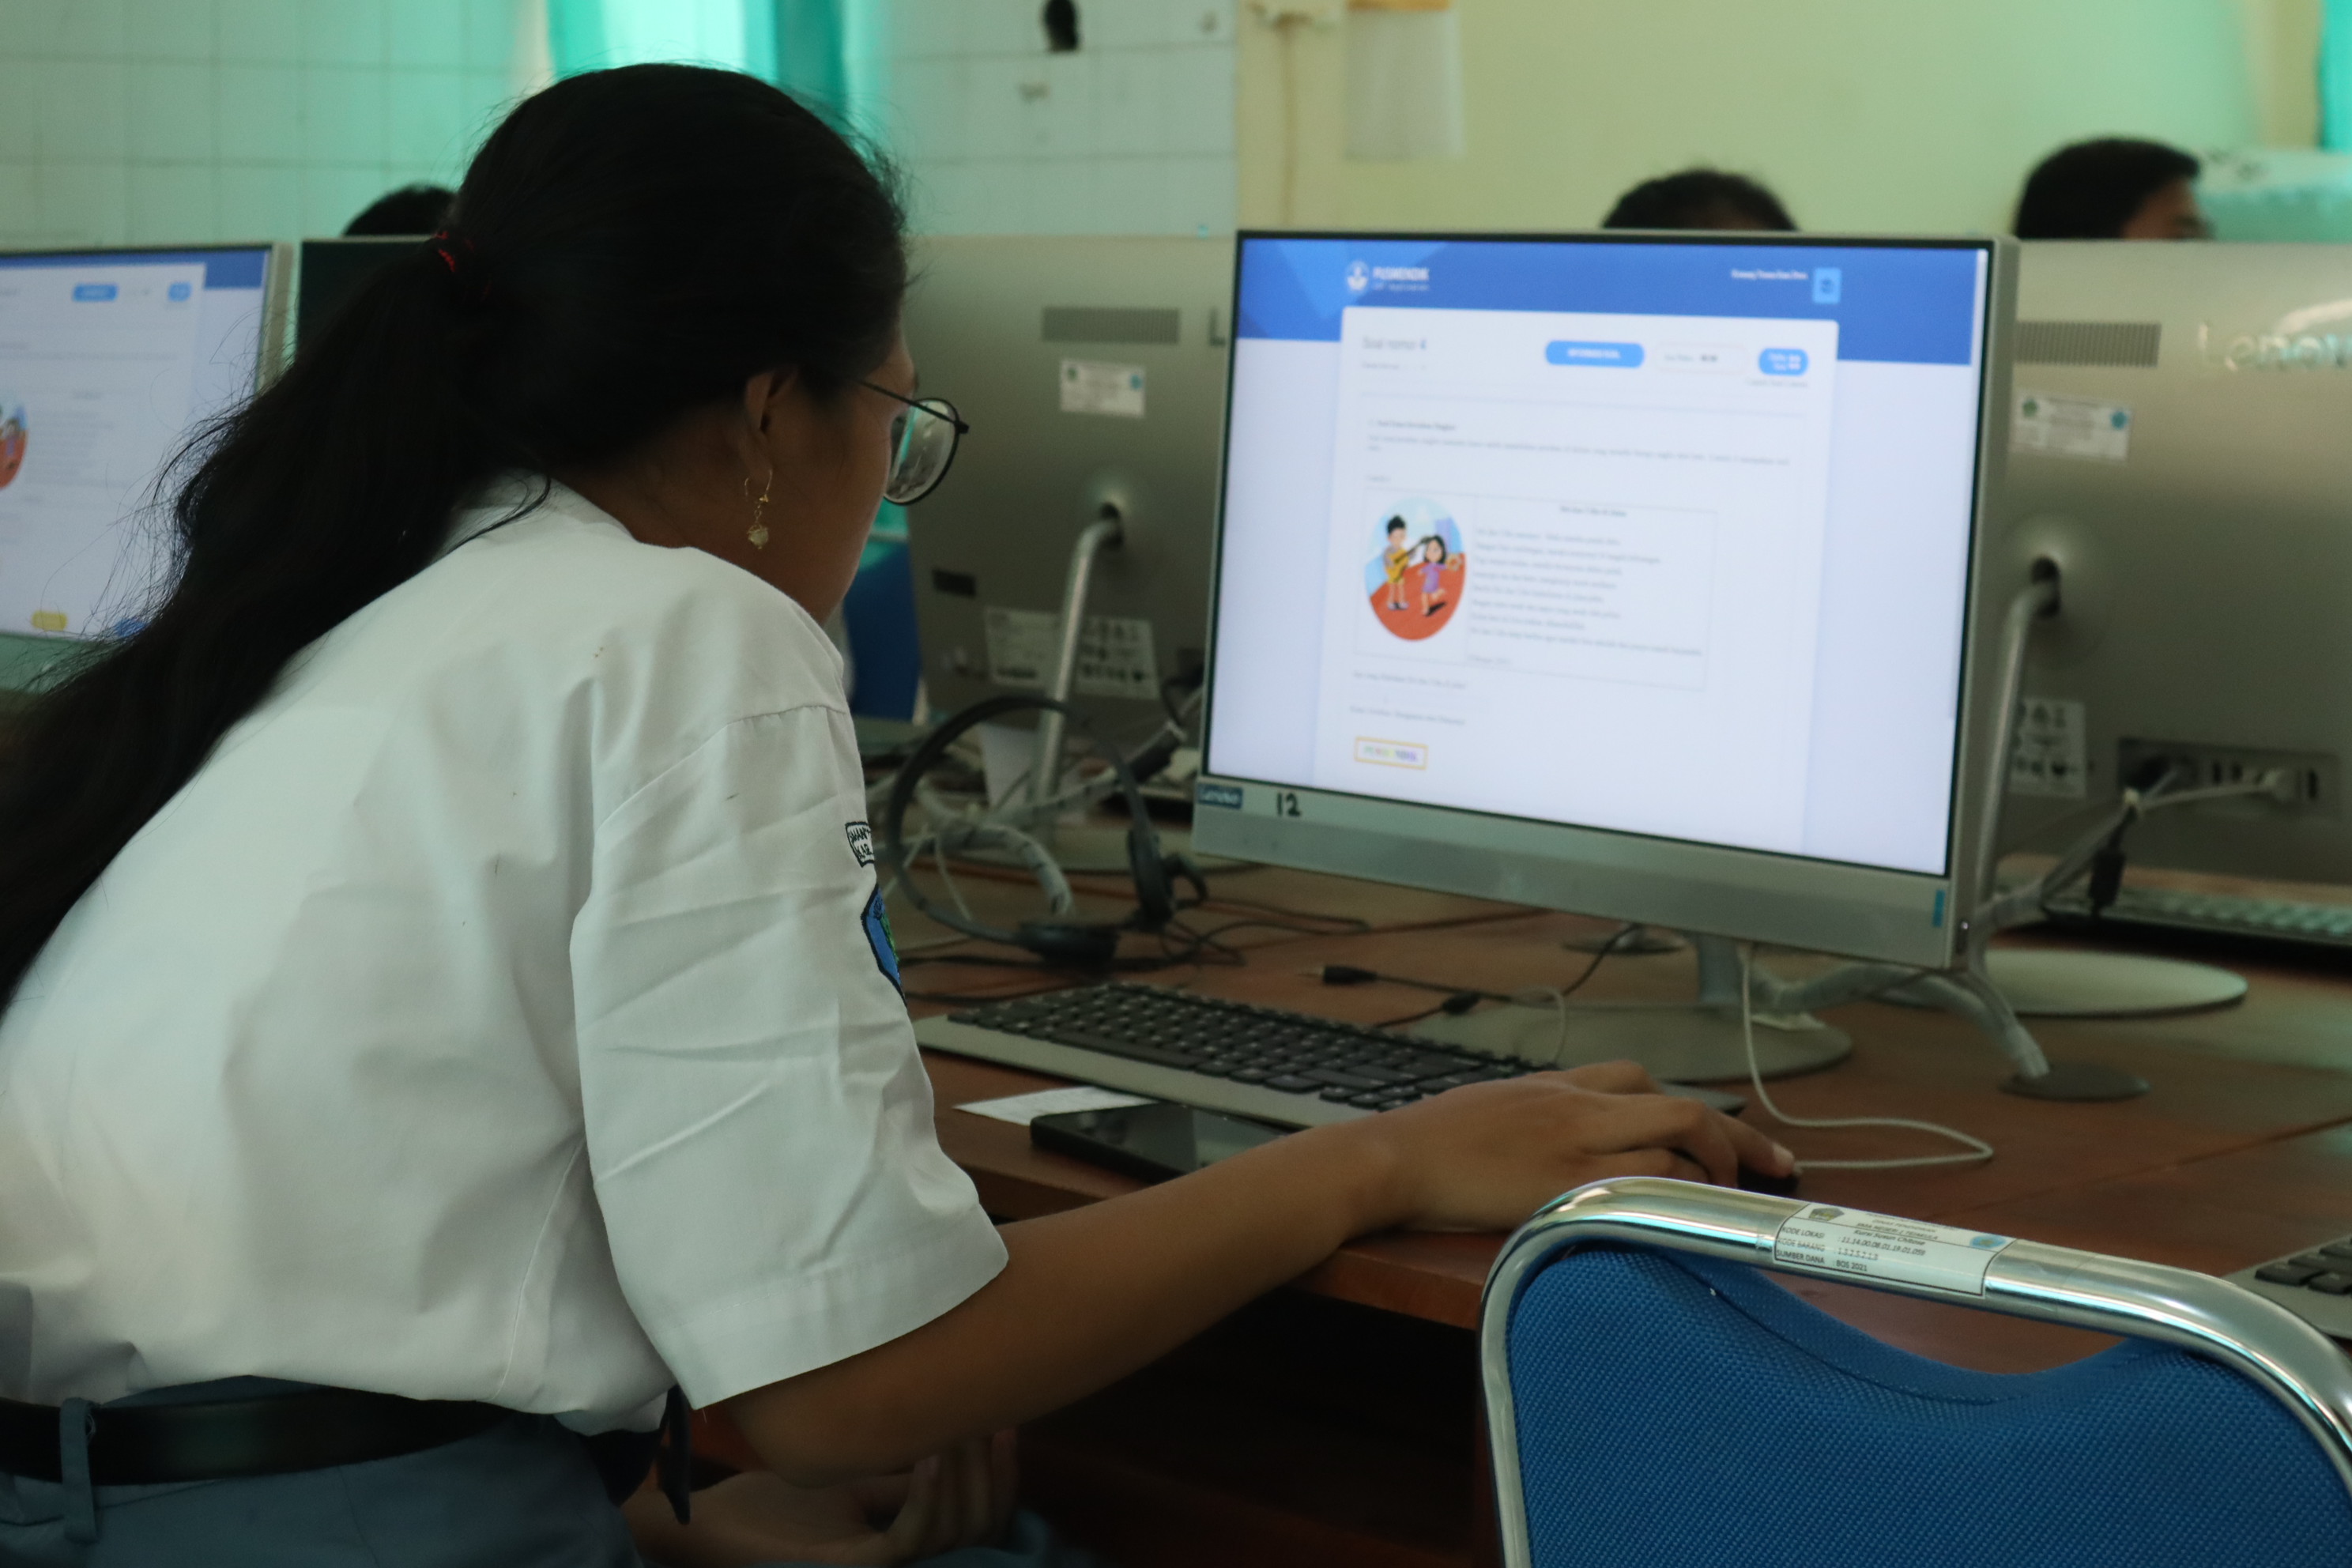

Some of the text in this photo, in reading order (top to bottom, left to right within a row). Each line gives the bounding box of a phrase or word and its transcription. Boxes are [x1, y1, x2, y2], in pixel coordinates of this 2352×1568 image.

[1276, 792, 1301, 817] 12
[1781, 1227, 1801, 1236] KODE
[1776, 1250, 1868, 1272] SUMBER DANA BOS 2021
